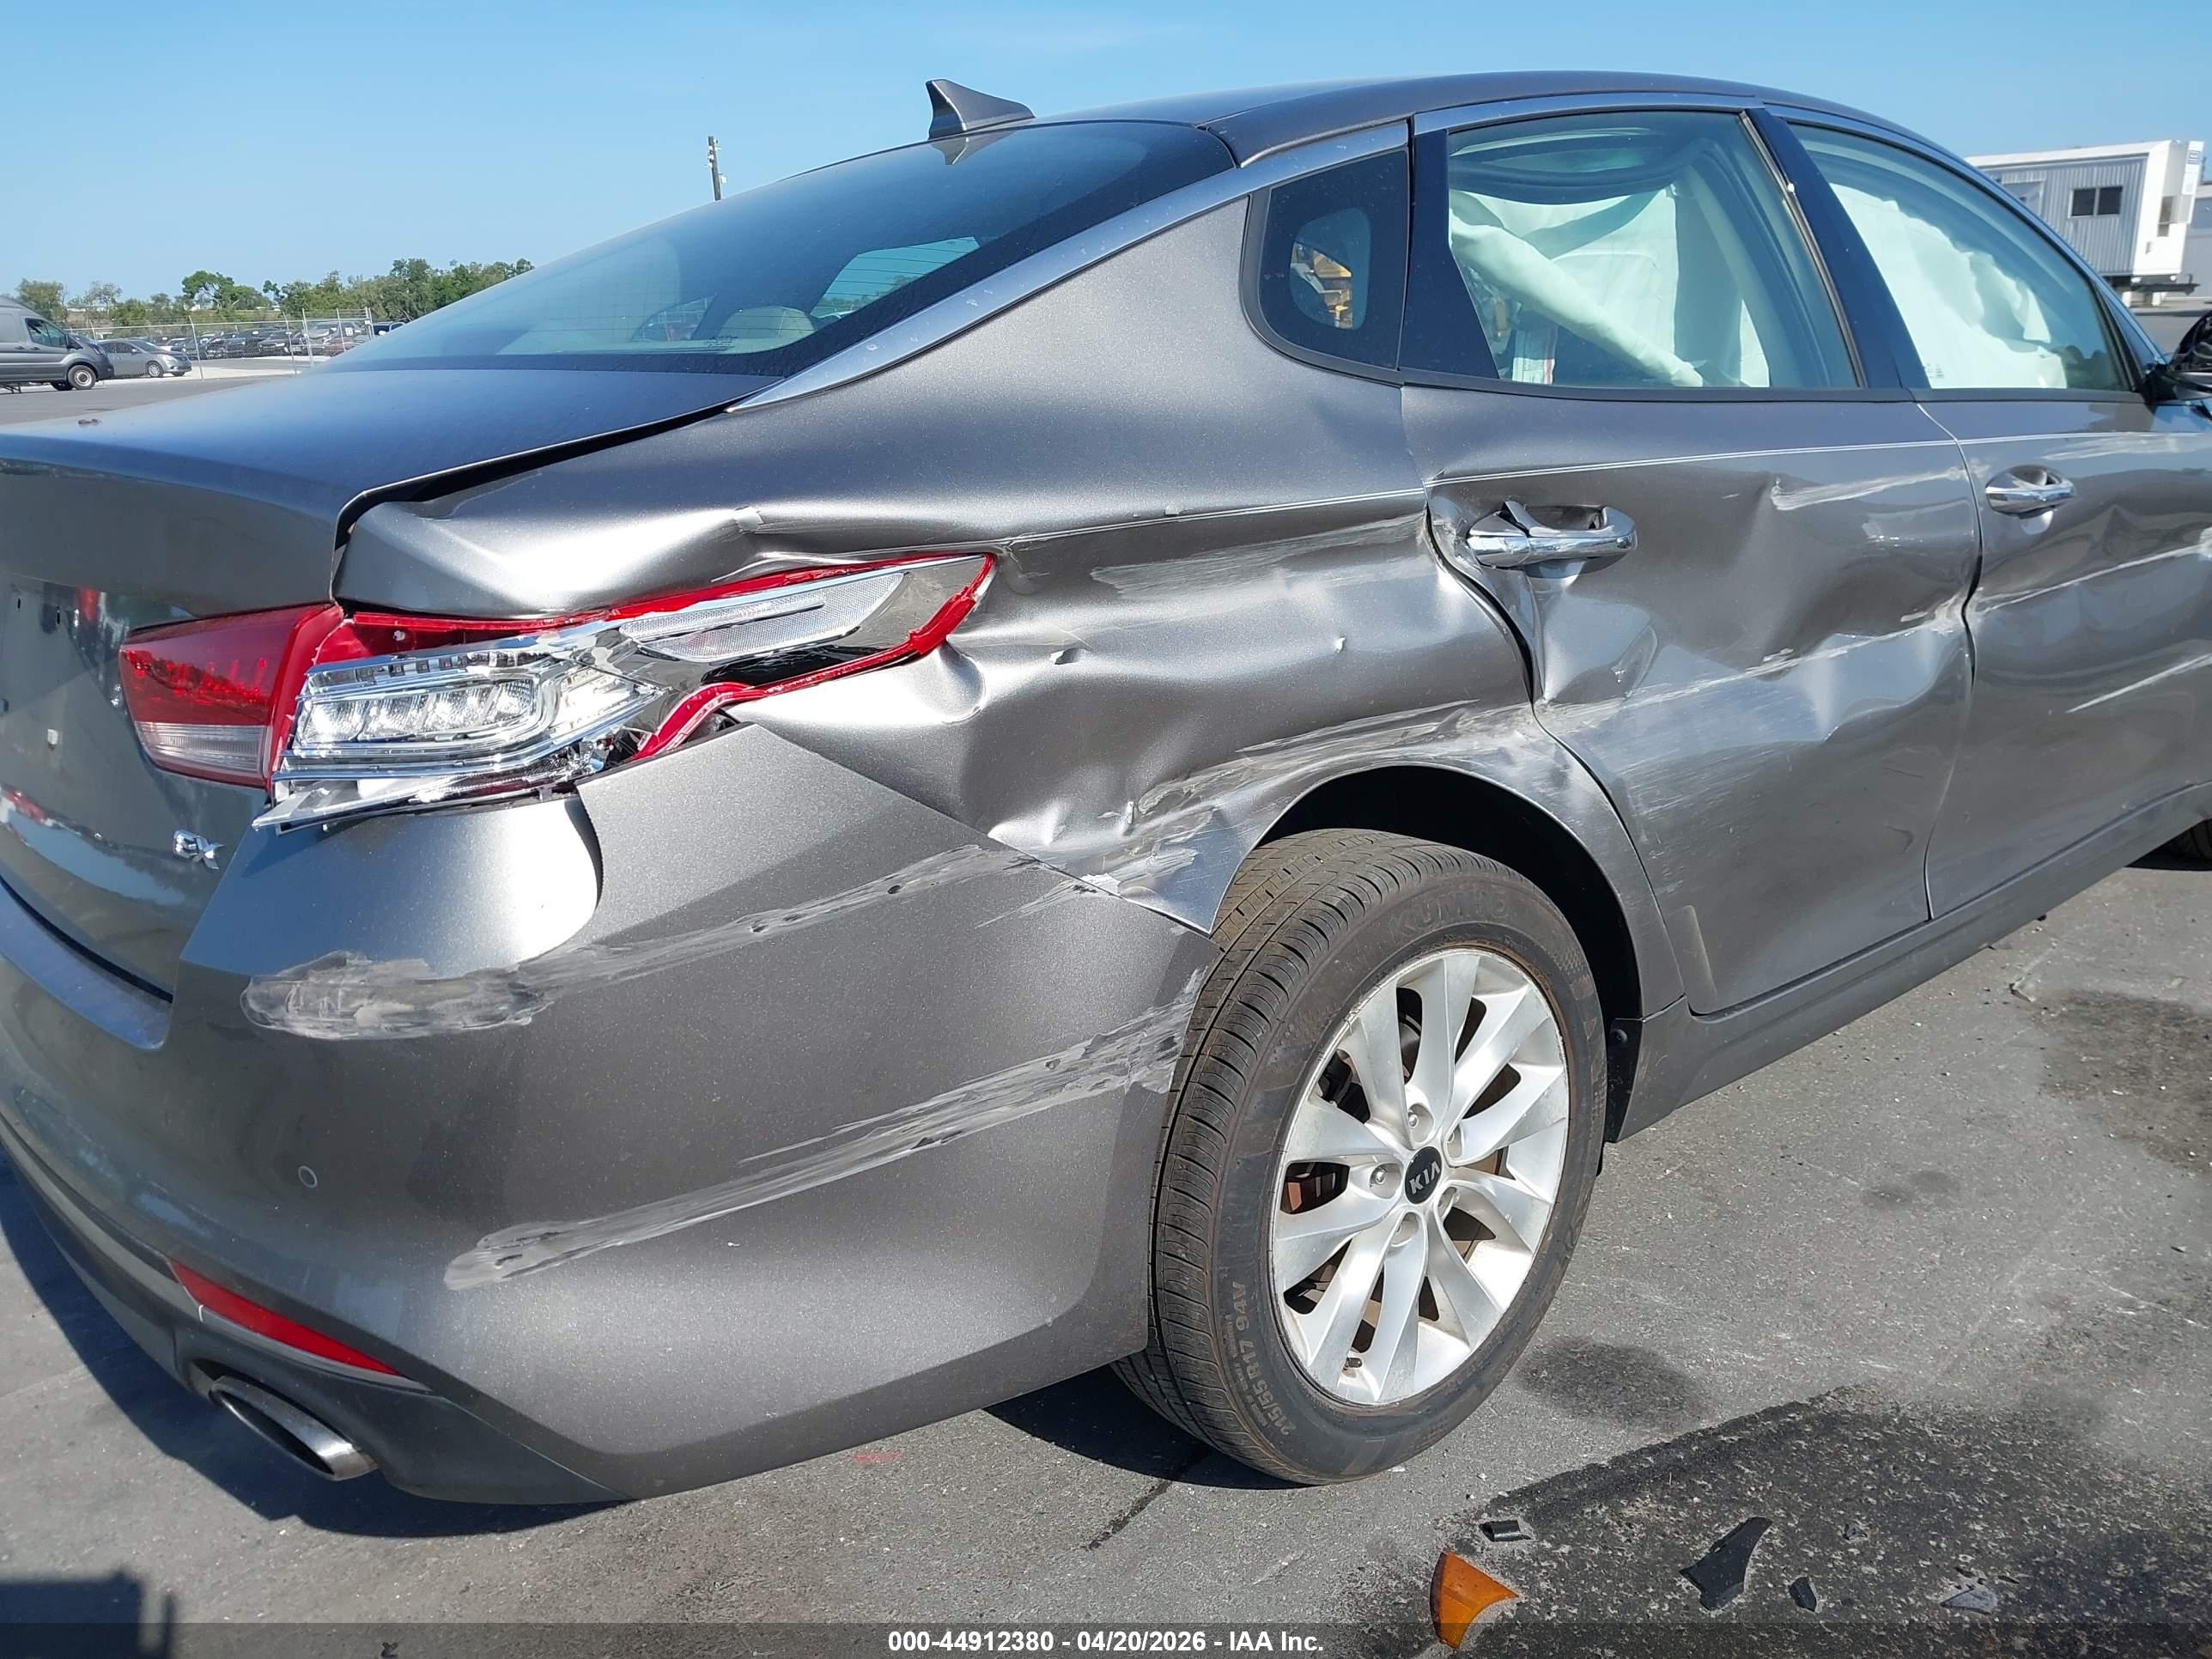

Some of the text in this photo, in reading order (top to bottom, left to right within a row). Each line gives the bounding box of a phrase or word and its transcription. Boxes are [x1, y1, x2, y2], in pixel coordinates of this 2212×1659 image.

[173, 830, 224, 872] EX
[1409, 1161, 1441, 1194] KIA
[1231, 1280, 1249, 1331] 94V
[1238, 1339, 1261, 1380] R17
[1252, 1379, 1297, 1436] 215/55
